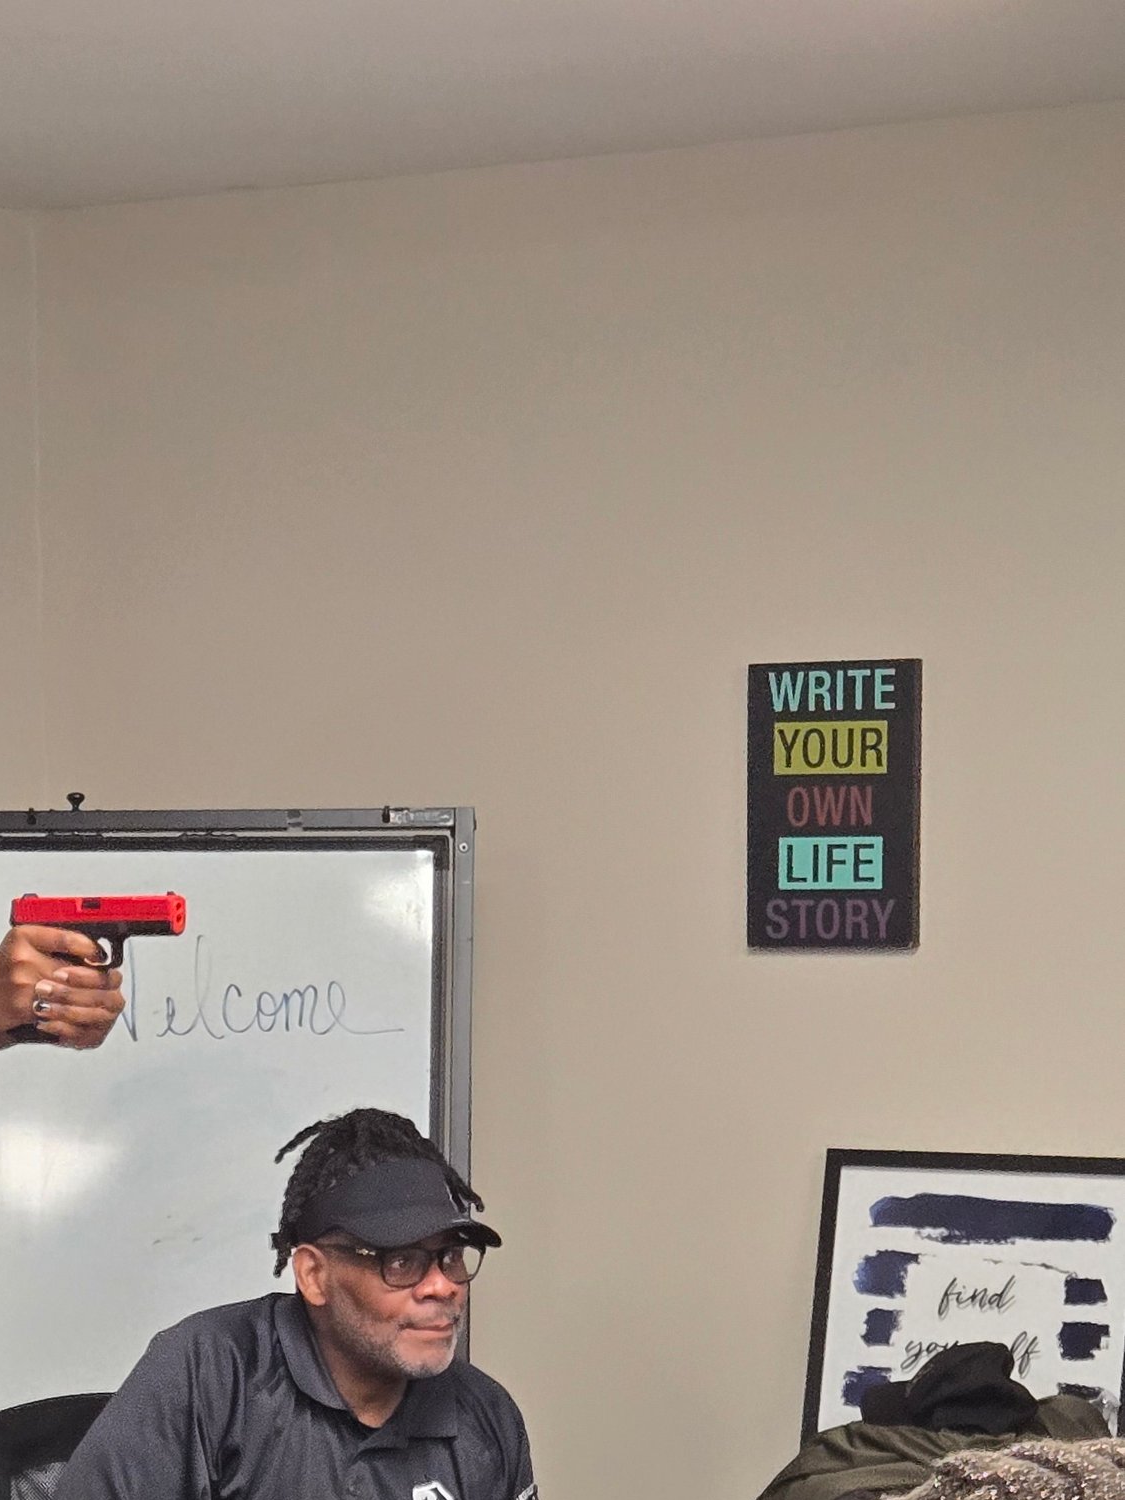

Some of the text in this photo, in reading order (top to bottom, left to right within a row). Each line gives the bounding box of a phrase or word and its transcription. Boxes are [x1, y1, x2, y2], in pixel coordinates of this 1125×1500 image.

[768, 667, 896, 712] WRITE
[777, 727, 884, 769] YOUR
[786, 784, 873, 828] OWN
[785, 843, 875, 884] LIFE
[765, 898, 895, 941] STORY
[937, 1274, 1016, 1319] find
[900, 1331, 1041, 1377] youlf
